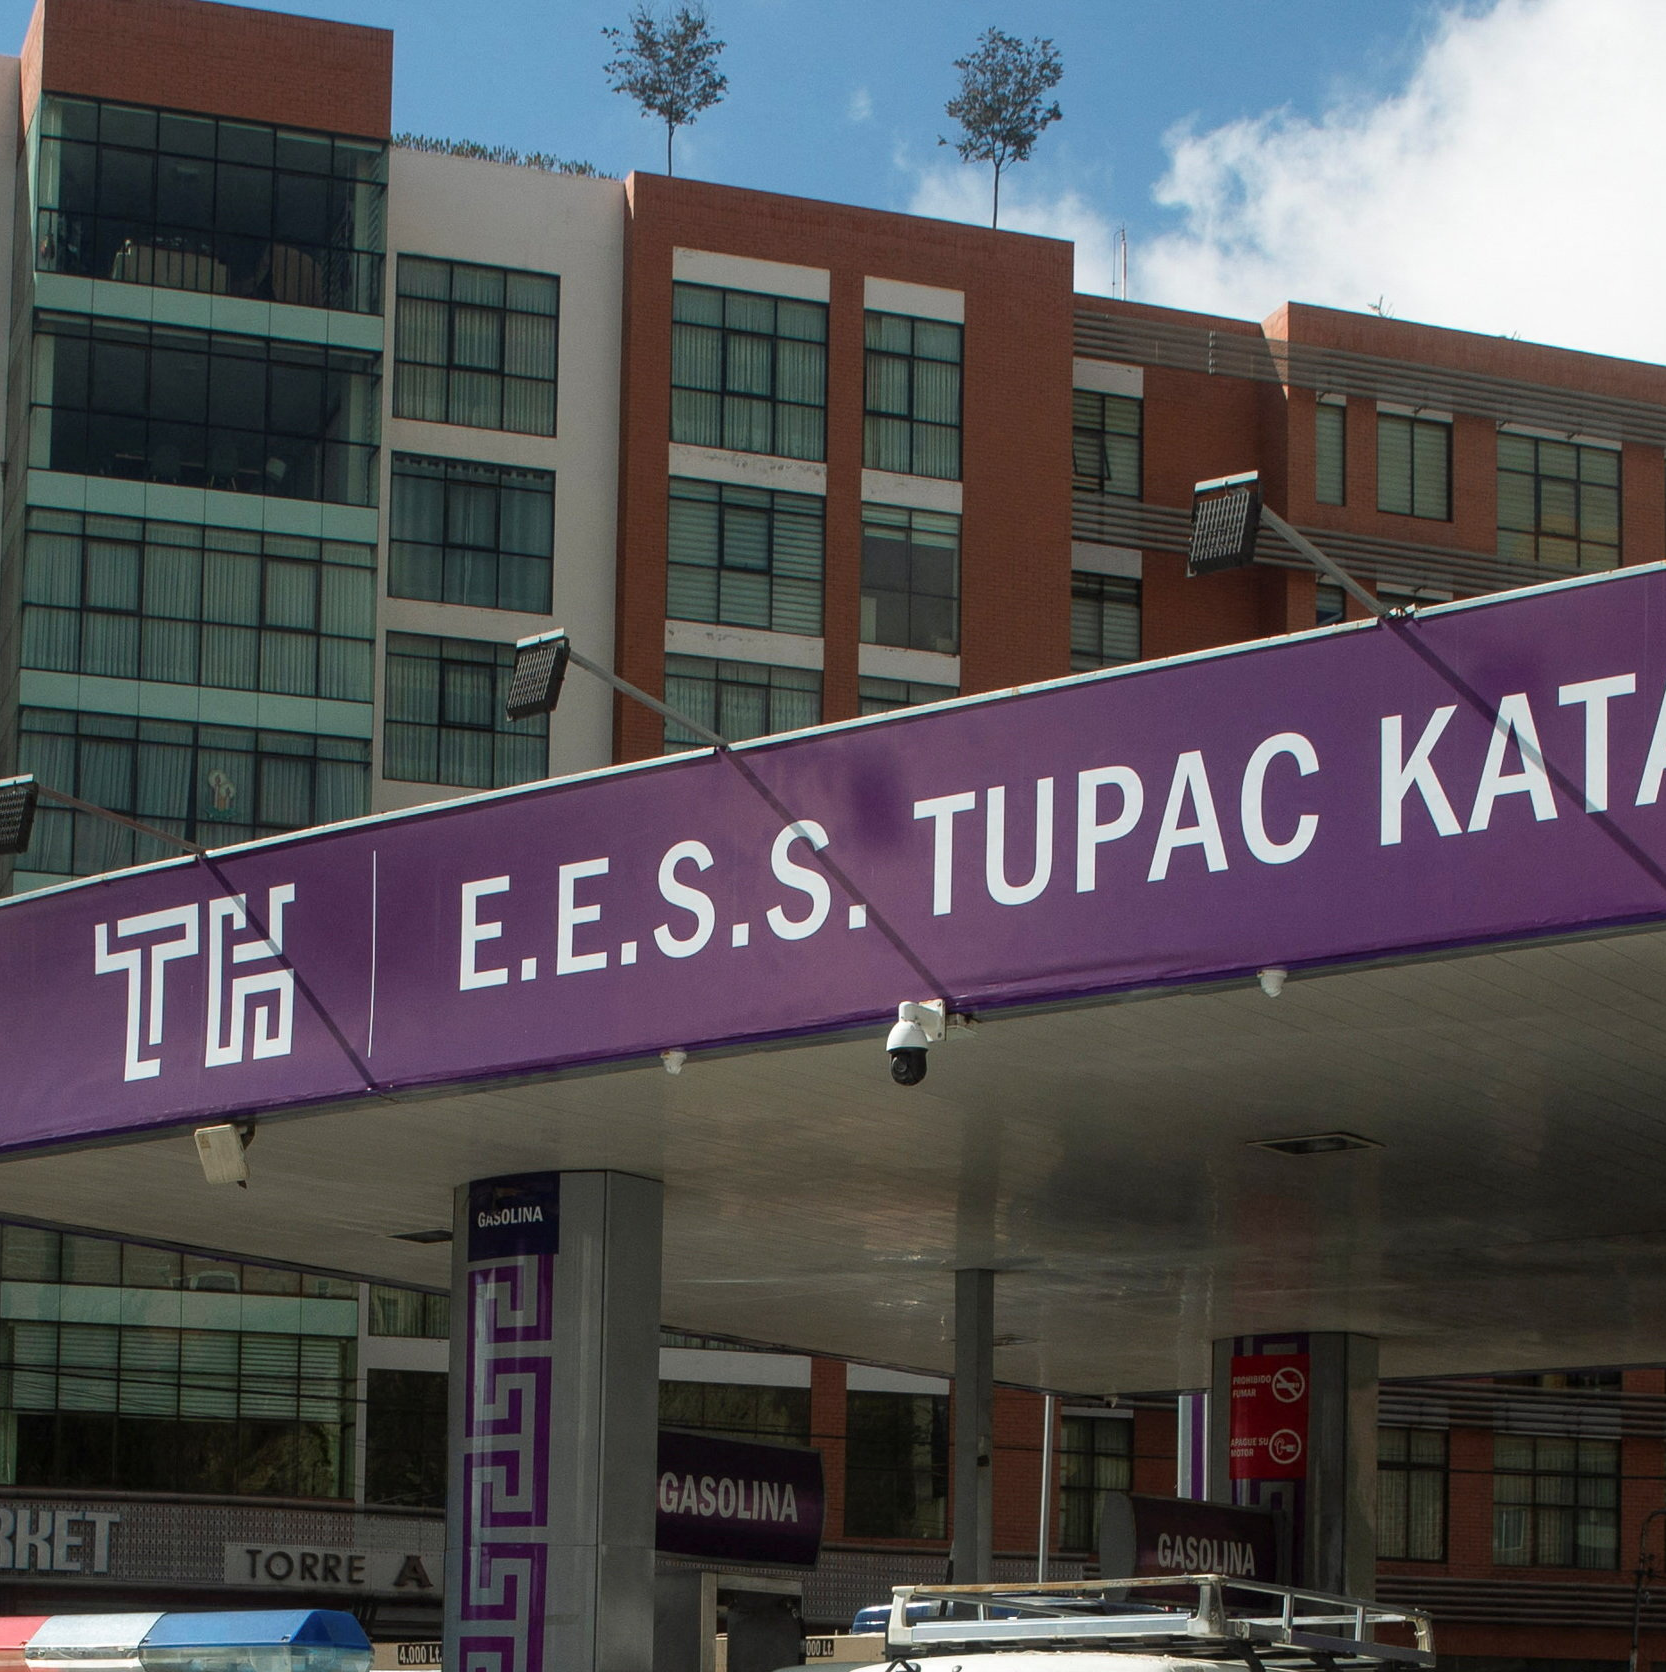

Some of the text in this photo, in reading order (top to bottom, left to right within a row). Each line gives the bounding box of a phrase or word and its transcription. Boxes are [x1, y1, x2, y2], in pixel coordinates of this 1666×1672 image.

[459, 820, 867, 991] E.E.S.S.
[913, 731, 1320, 917] TUPAC
[478, 1206, 543, 1228] GASOLINA
[1233, 1374, 1271, 1386] PROHIBIDO
[1233, 1388, 1256, 1398] FUMAR
[1231, 1437, 1269, 1448] APAGUE SU
[1231, 1448, 1254, 1458] MOTOR
[659, 1472, 798, 1523] GASOLINA
[1157, 1532, 1256, 1576] GASOLINA
[246, 1548, 433, 1588] TORRE A
[399, 1645, 442, 1664] 4.000 Lt.
